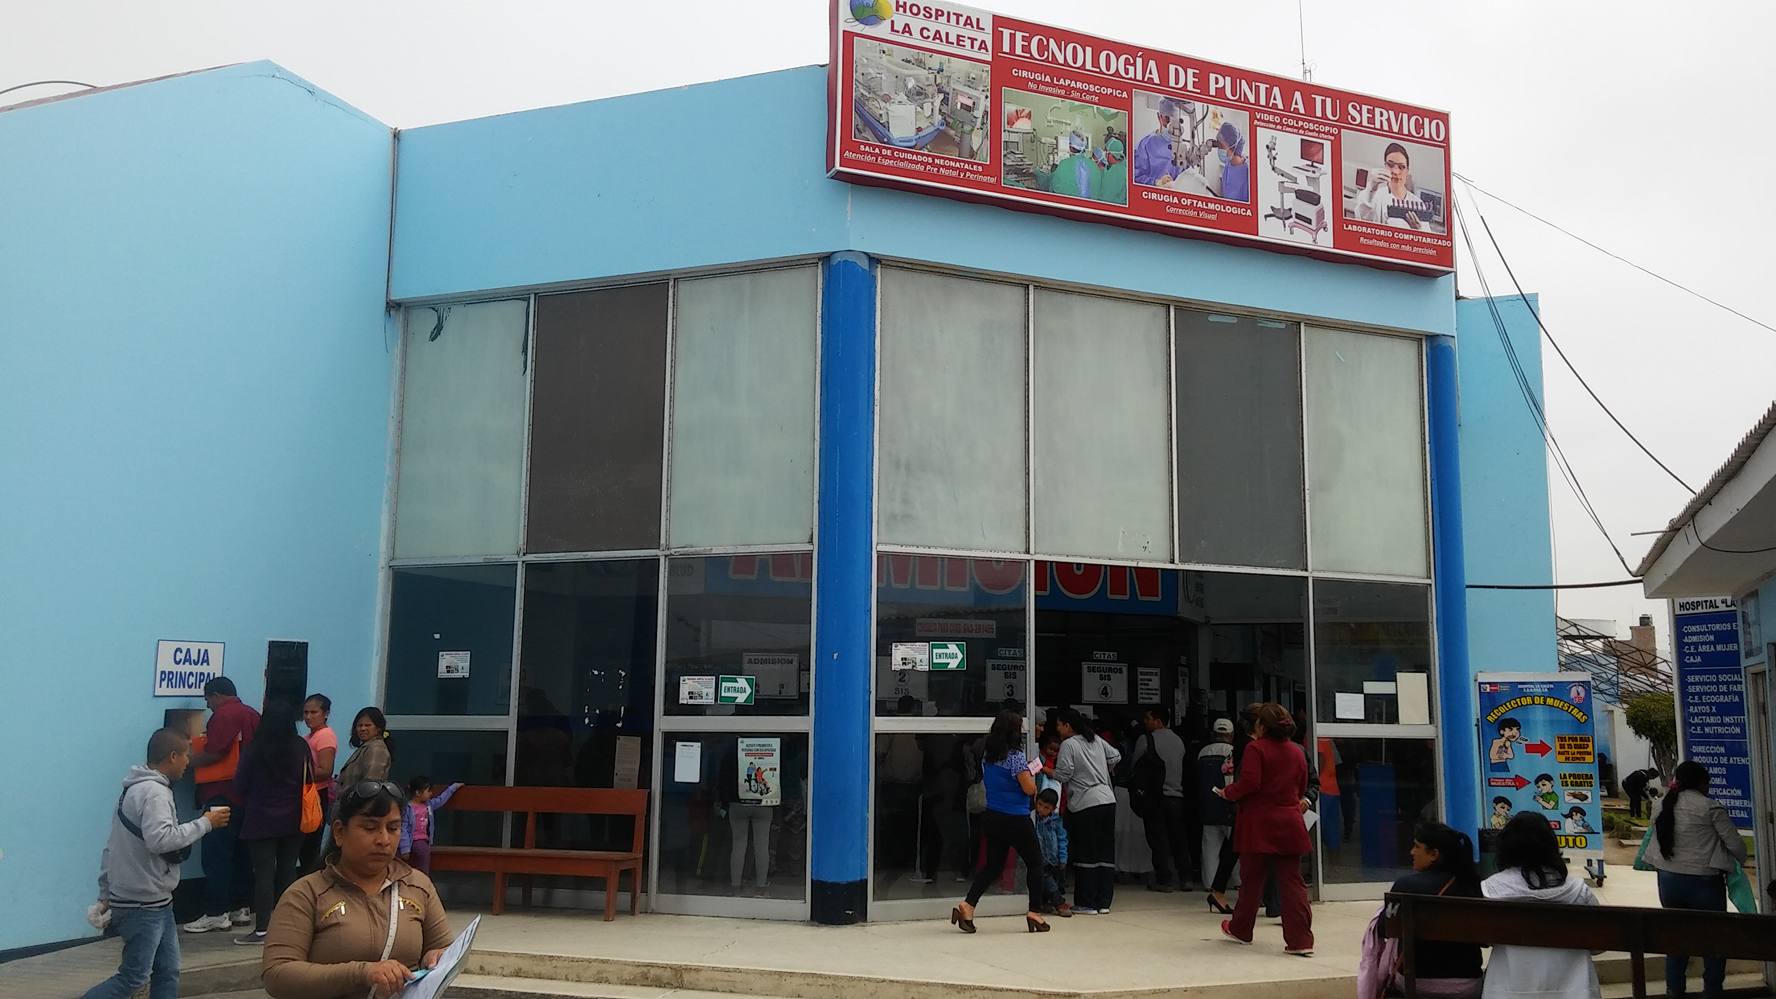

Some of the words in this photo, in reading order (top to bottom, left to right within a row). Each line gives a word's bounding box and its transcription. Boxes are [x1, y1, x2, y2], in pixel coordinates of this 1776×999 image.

[895, 0, 986, 31] HOSPITAL
[890, 19, 913, 36] LA
[919, 26, 989, 52] CALETA
[998, 27, 1160, 84] TECNOLOGÍA
[1169, 63, 1200, 92] DE
[1209, 73, 1284, 110] PUNTA
[1290, 91, 1306, 114] A
[1311, 94, 1341, 121] TU
[1347, 102, 1446, 142] SERVICIO
[1053, 76, 1128, 98] LAPAROSCOPICA
[1027, 81, 1038, 89] No
[1039, 83, 1065, 95] Invasiva
[1071, 90, 1081, 98] Sin
[1082, 92, 1100, 102] Corte
[1255, 112, 1280, 122] VIDEO
[1282, 118, 1338, 134] COLPOSCOPIO
[859, 144, 880, 154] SALA
[881, 148, 892, 156] DE
[894, 150, 933, 163] CUIDADOS
[934, 157, 983, 172] NEONATALES
[843, 150, 876, 162] Atención
[877, 157, 925, 171] Especializada
[926, 164, 938, 173] Pre
[939, 167, 959, 177] Natal
[960, 171, 965, 179] y
[966, 171, 997, 183] Perinatal
[1166, 205, 1198, 217] Corrección
[1199, 210, 1218, 221] Visual
[1180, 198, 1252, 216] OFTALMOLOGICA
[1343, 223, 1393, 237] LABORATORIO
[1394, 231, 1452, 247] COMPUTARIZADO
[1360, 236, 1389, 248] Resultados
[1679, 599, 1719, 611] HOSPITAL
[1716, 643, 1738, 651] MUJER
[173, 647, 210, 666] CAJA
[935, 652, 958, 660] ENTRADA
[1094, 652, 1117, 660] CITAS
[1004, 671, 1017, 680] SIS
[1086, 665, 1123, 674] SEGUROS
[898, 671, 907, 683] 2
[1099, 674, 1112, 682] SIS
[723, 685, 747, 694] ENTRADA
[894, 687, 910, 695] SIS
[1006, 684, 1014, 697] 3
[1101, 685, 1109, 698] 4
[1487, 696, 1533, 723] RECOLECTOR
[1534, 696, 1545, 705] DE
[1546, 696, 1589, 723] MUESTRAS
[1711, 705, 1717, 713] X
[1704, 725, 1741, 734] NUTRICIÓN
[1720, 756, 1728, 764] DE
[1728, 809, 1749, 818] LEGAL
[1557, 835, 1587, 848] UTO
